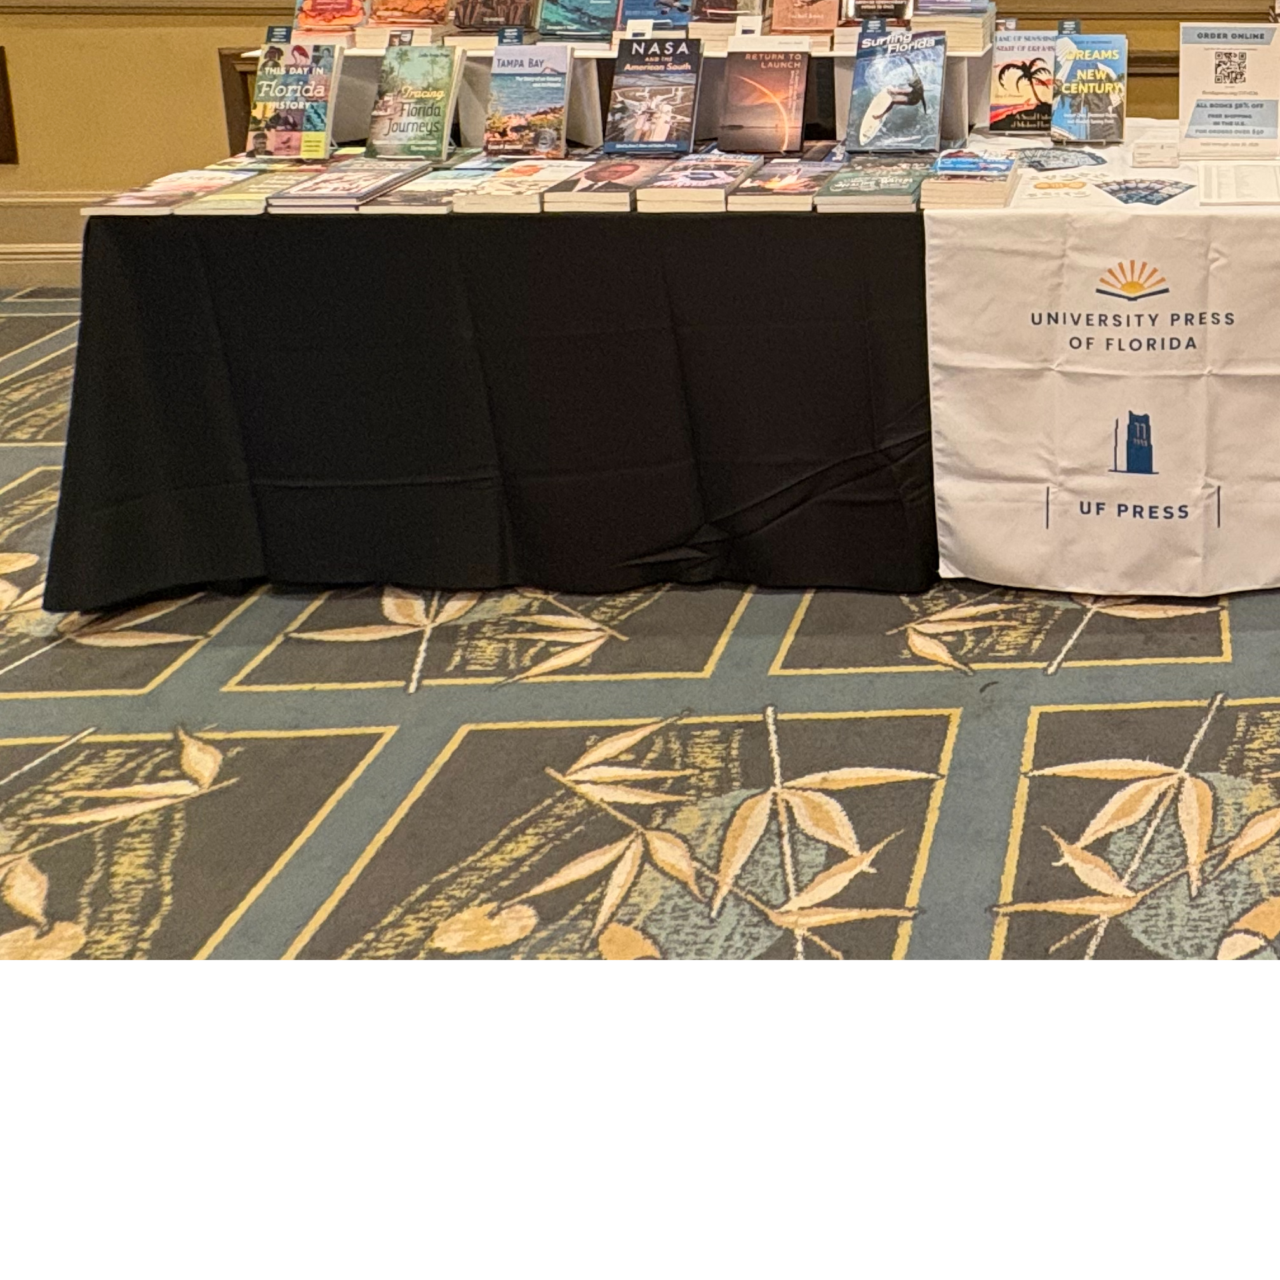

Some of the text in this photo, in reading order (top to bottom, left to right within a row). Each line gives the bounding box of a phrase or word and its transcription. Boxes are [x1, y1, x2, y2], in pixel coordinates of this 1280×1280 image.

[861, 32, 913, 50] Surfing
[1197, 32, 1228, 40] ORDER
[632, 42, 689, 55] NASA
[887, 38, 936, 55] Florida
[745, 53, 785, 61] RETURN
[1066, 50, 1120, 60] DREAMS
[496, 58, 545, 68] TAMPA BAY
[265, 67, 324, 75] THIS DAY IN
[1077, 69, 1106, 80] NEW
[258, 80, 326, 97] Florida
[401, 86, 446, 100] Tracing
[1062, 83, 1122, 94] CENTURY
[269, 102, 311, 110] HISTORY
[400, 103, 442, 118] Florida
[384, 120, 441, 136] Journeys
[1030, 312, 1235, 328] UNIVERSITY PRESS
[1069, 337, 1197, 352] OF FLORIDA
[1079, 501, 1189, 520] UF PRESS
